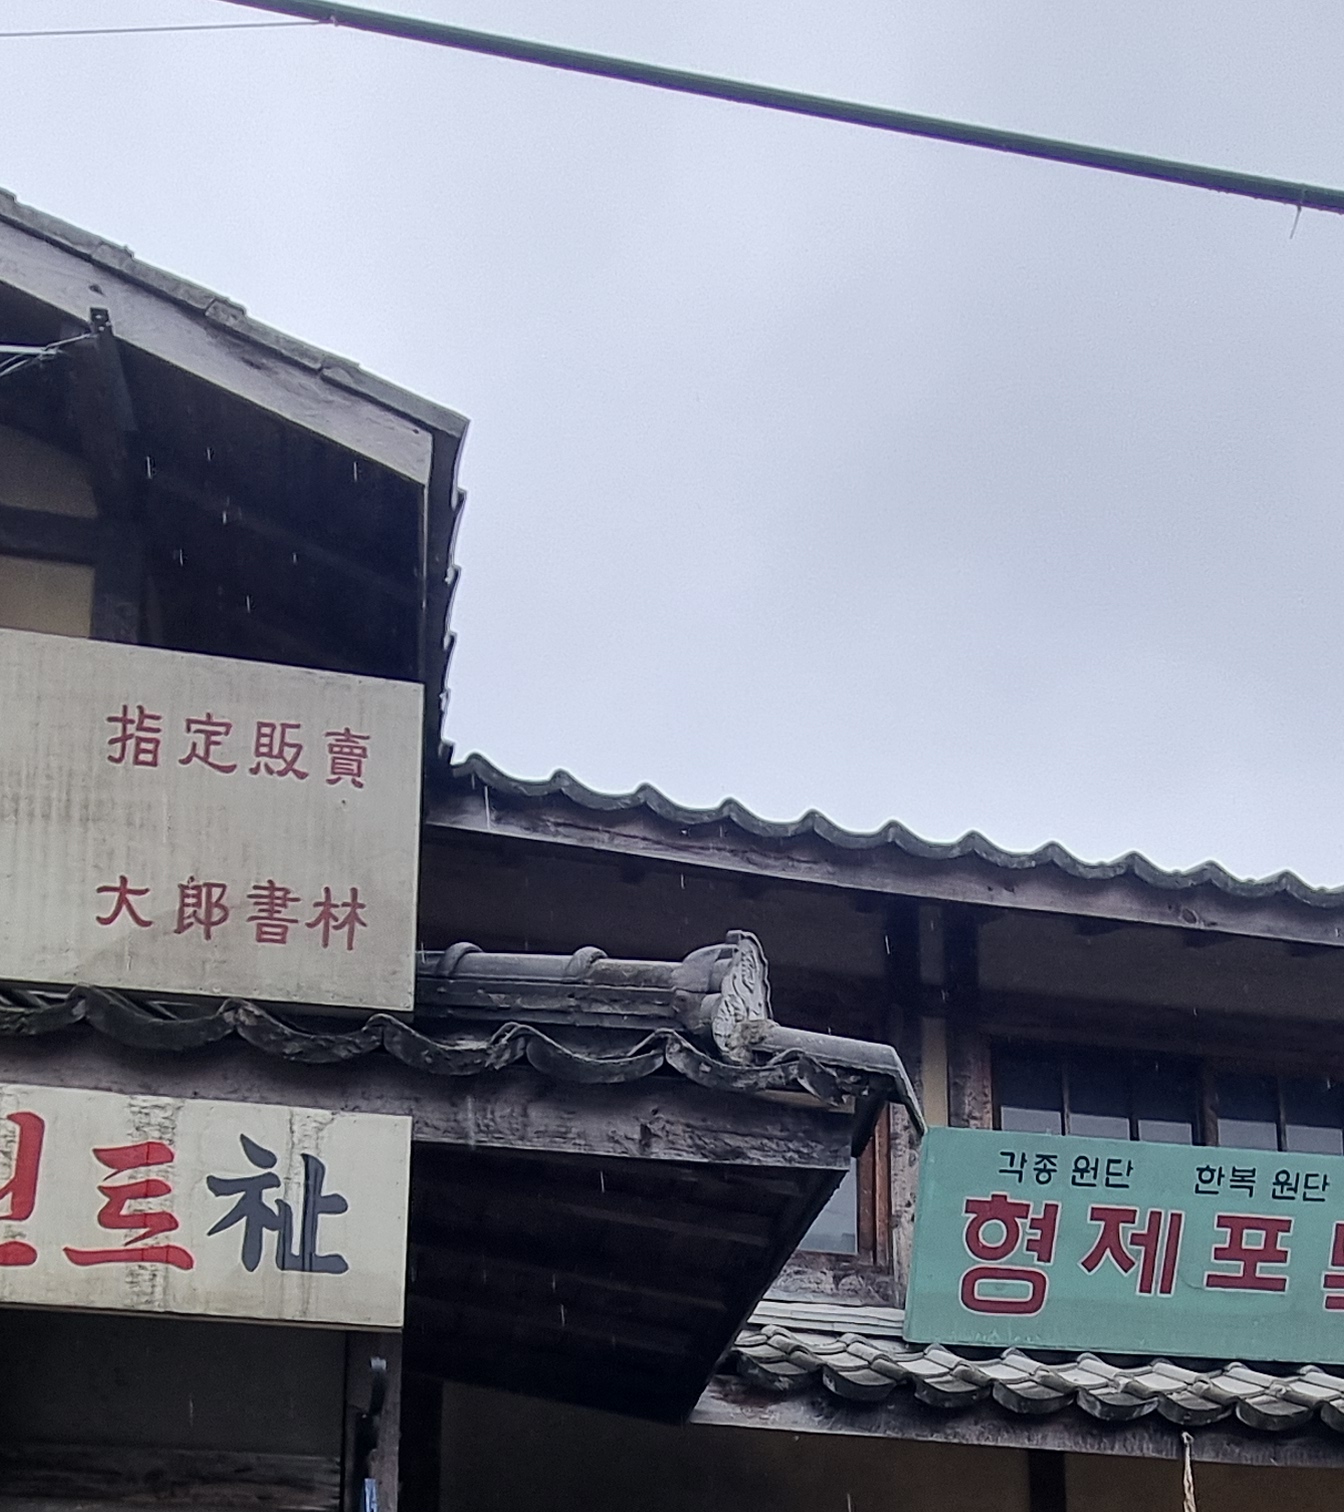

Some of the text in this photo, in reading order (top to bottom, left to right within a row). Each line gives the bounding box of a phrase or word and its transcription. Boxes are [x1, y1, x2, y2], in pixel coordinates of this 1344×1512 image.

[106, 704, 371, 789] 指定販賣
[95, 875, 368, 951] 大郎書林
[998, 1150, 1059, 1186] 각종
[1070, 1155, 1135, 1190] 원단
[1193, 1164, 1258, 1199] 한복
[1271, 1169, 1332, 1203] 원단
